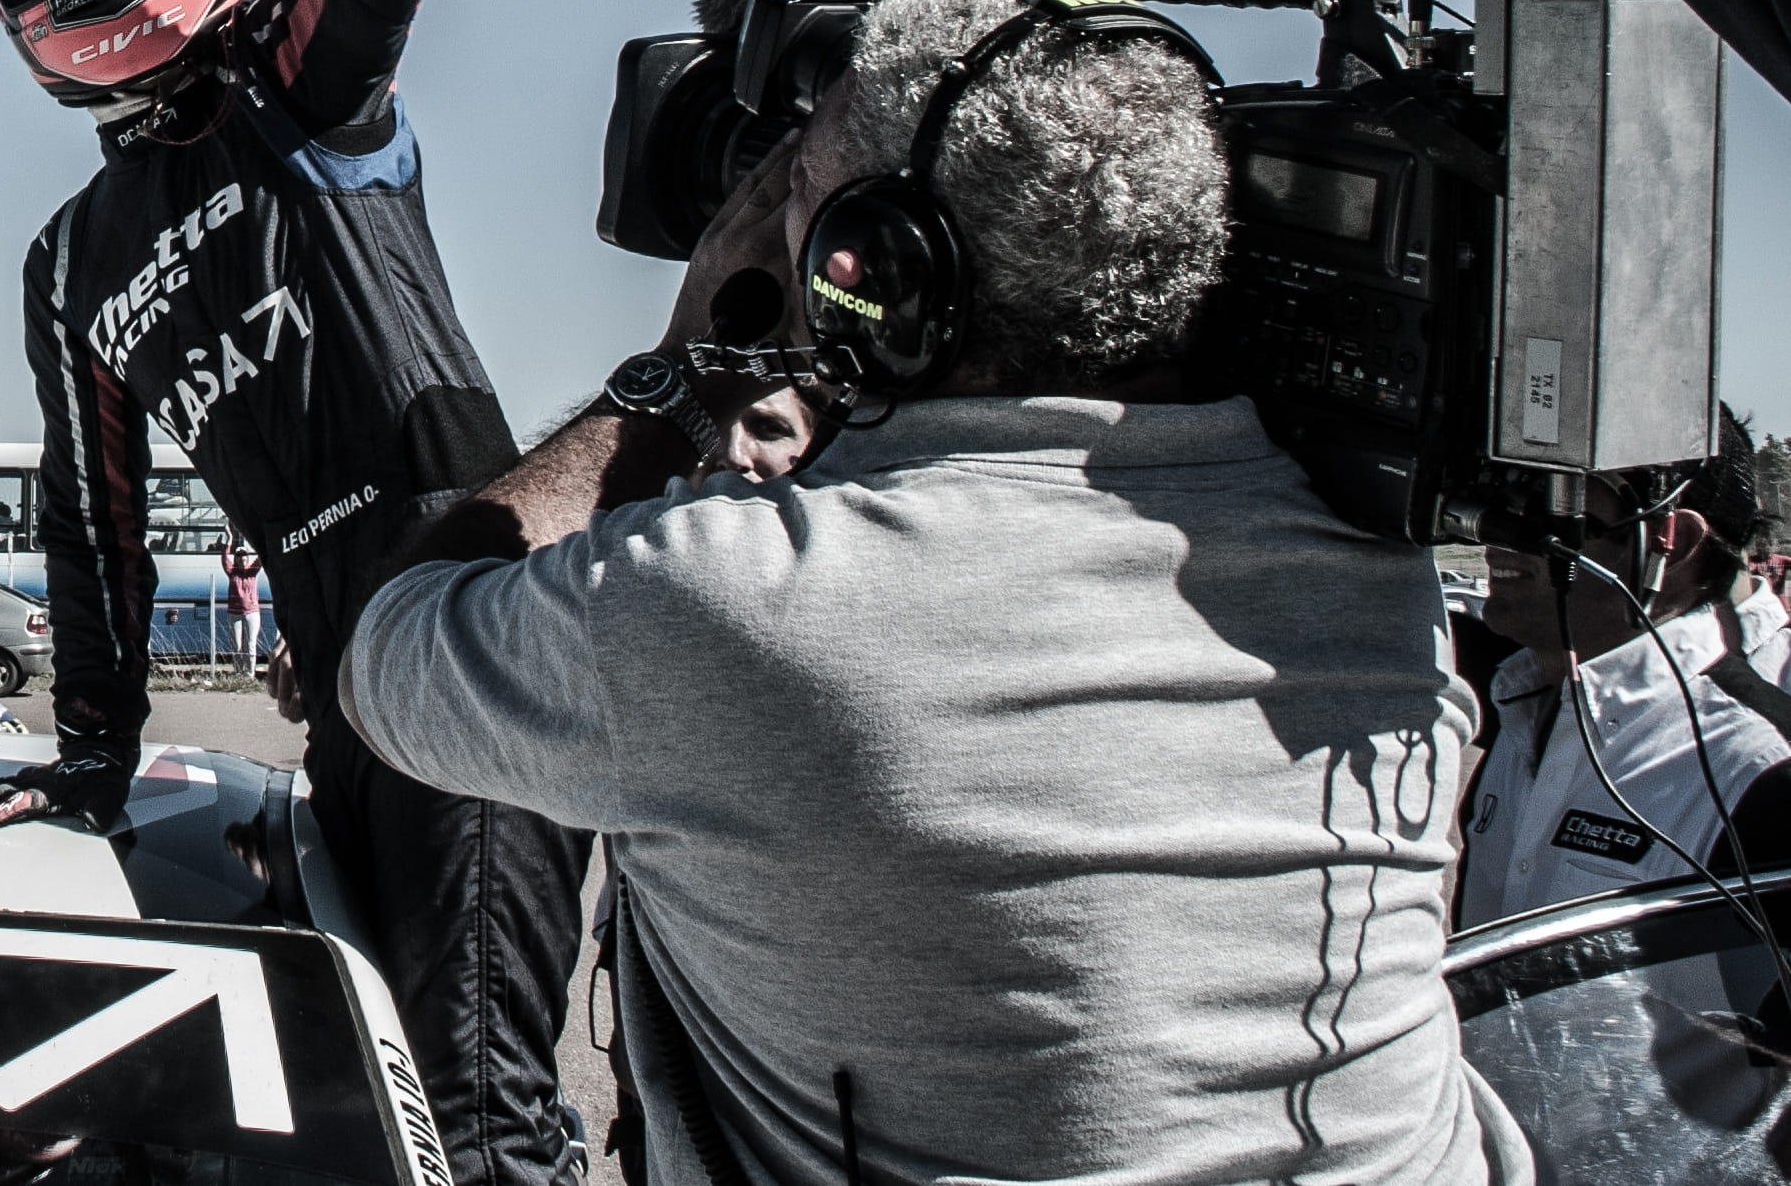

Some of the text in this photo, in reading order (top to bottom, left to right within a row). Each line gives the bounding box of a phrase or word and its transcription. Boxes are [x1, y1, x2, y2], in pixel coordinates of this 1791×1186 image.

[71, 5, 186, 65] CIVIC
[812, 274, 883, 321] DAVICOM
[281, 527, 309, 554] LEO
[308, 492, 363, 537] PERNIA
[1560, 833, 1610, 851] RACING
[1565, 816, 1641, 847] Chetta
